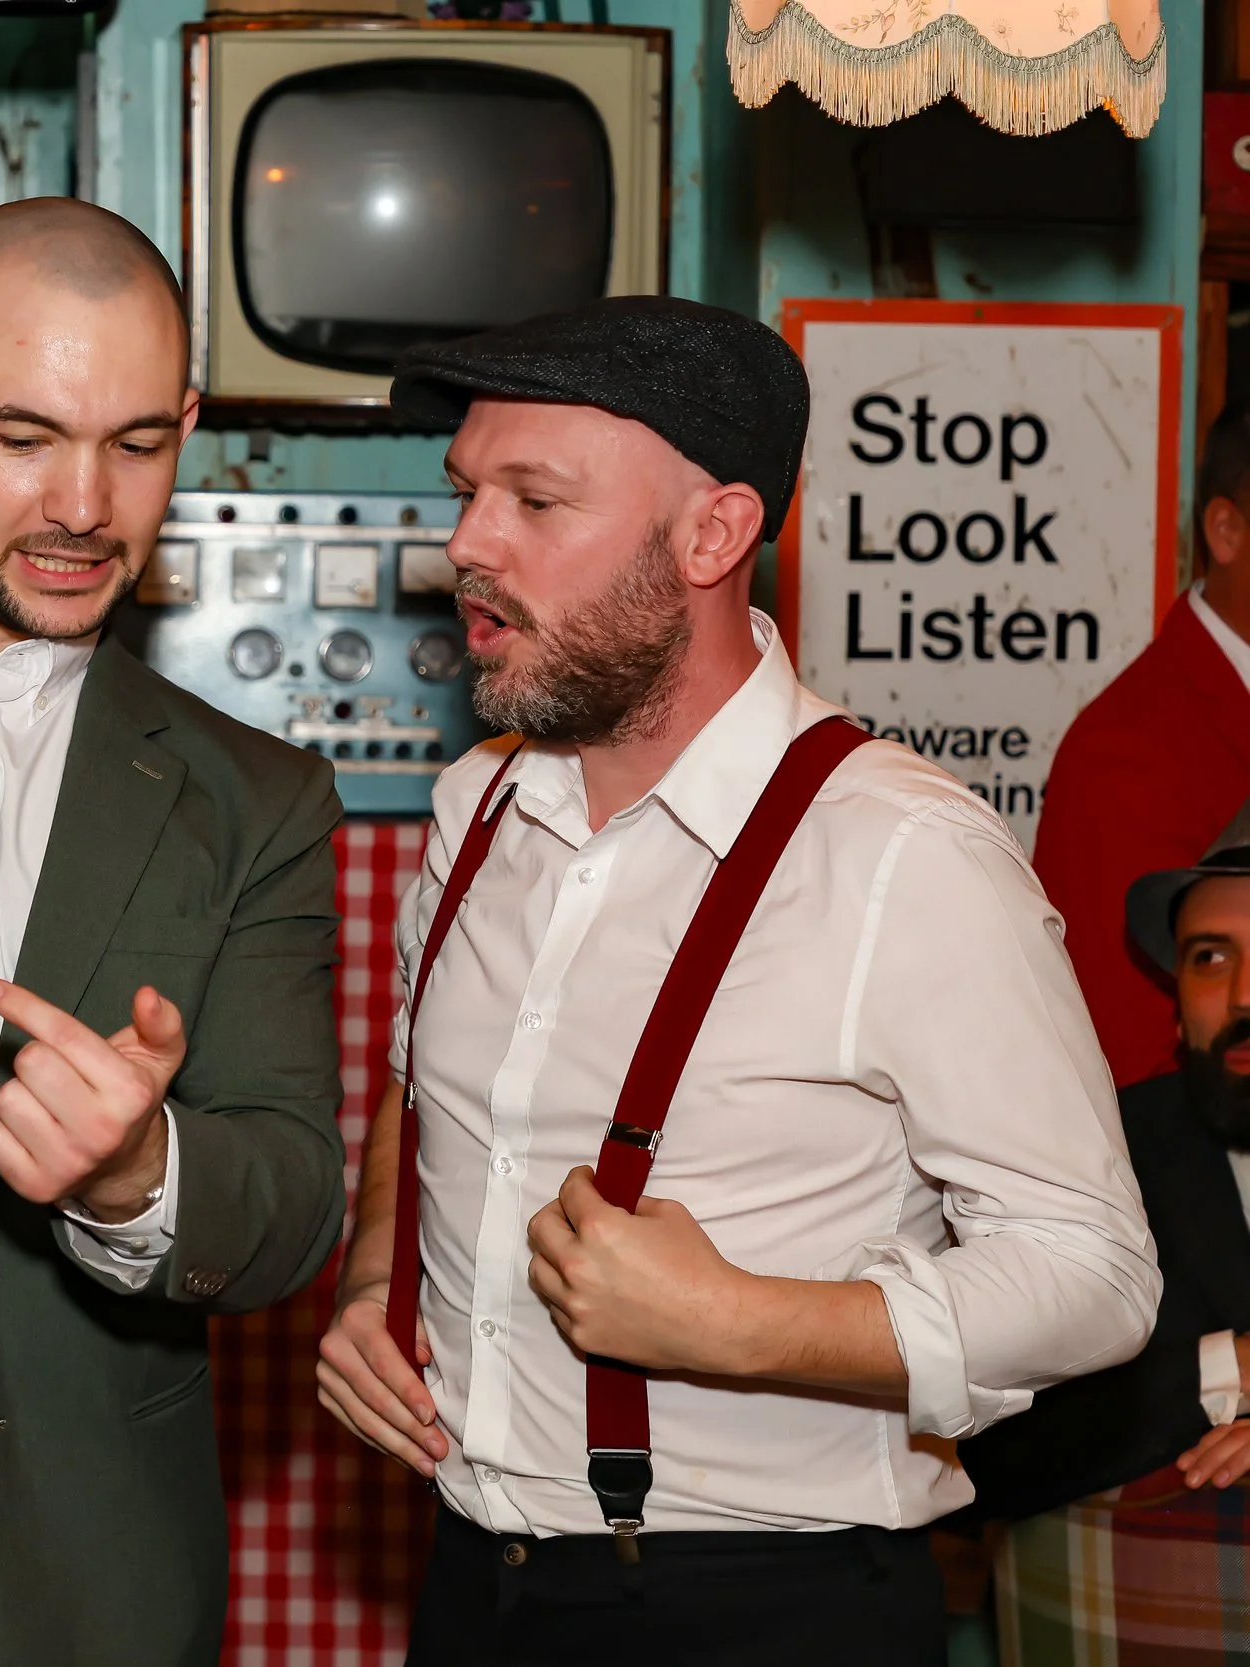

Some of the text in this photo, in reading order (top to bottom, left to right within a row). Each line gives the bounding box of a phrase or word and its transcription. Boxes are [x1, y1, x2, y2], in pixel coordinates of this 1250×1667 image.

[850, 391, 1049, 482] Stop
[848, 492, 1059, 565] Look
[847, 590, 1101, 662] Listen
